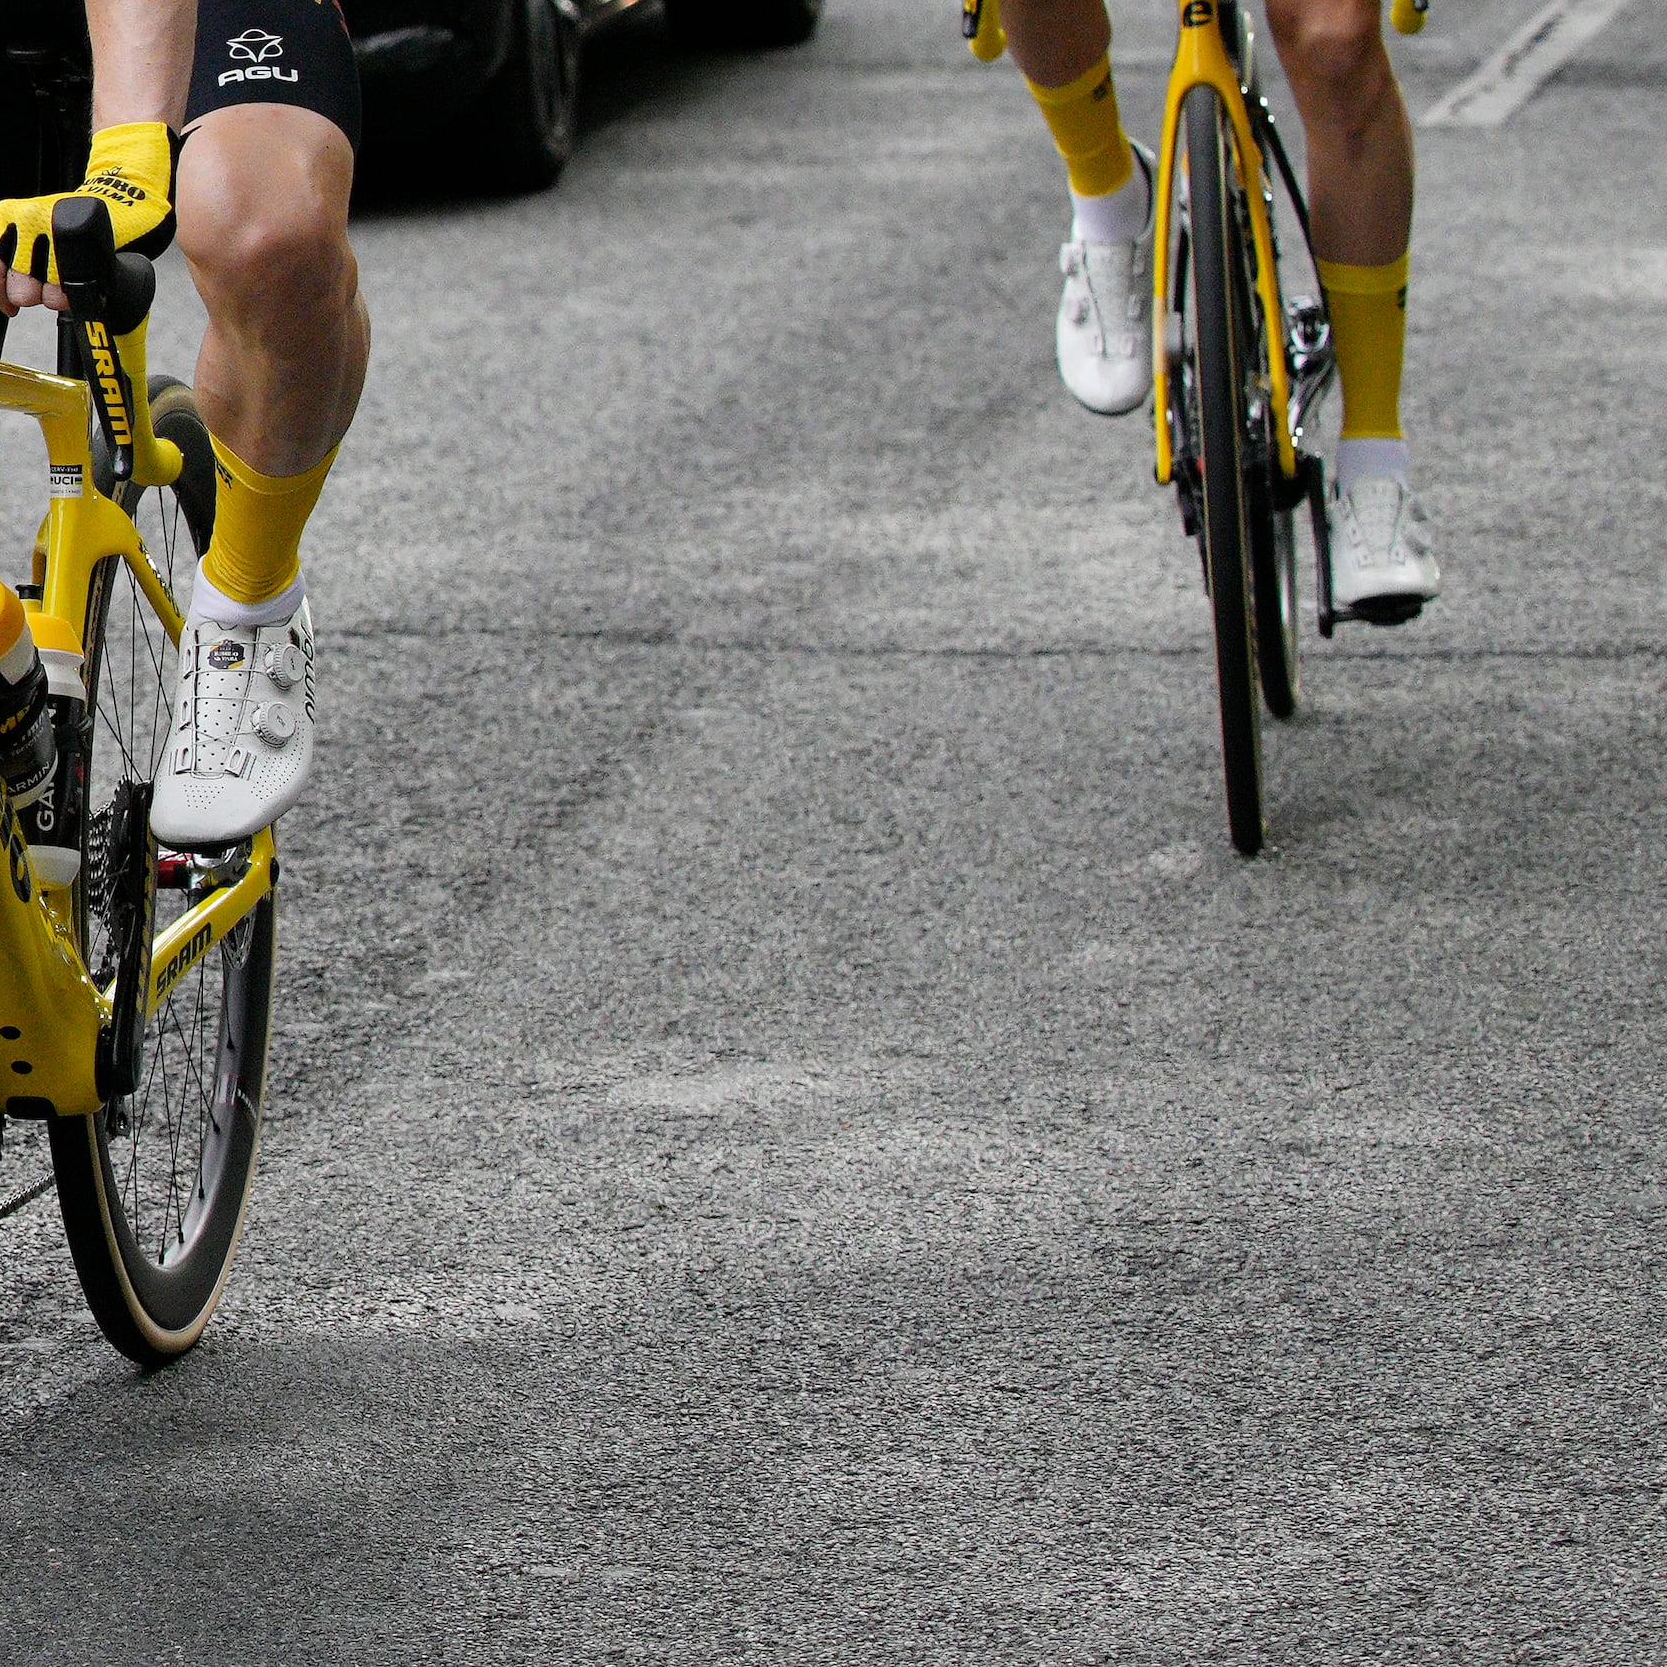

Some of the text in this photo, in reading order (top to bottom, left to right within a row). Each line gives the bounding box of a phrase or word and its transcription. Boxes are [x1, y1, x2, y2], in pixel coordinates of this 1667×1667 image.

[217, 66, 301, 87] AGU
[84, 320, 133, 446] SRAM
[6, 761, 52, 796] ARMIN
[156, 922, 213, 994] SRAM
